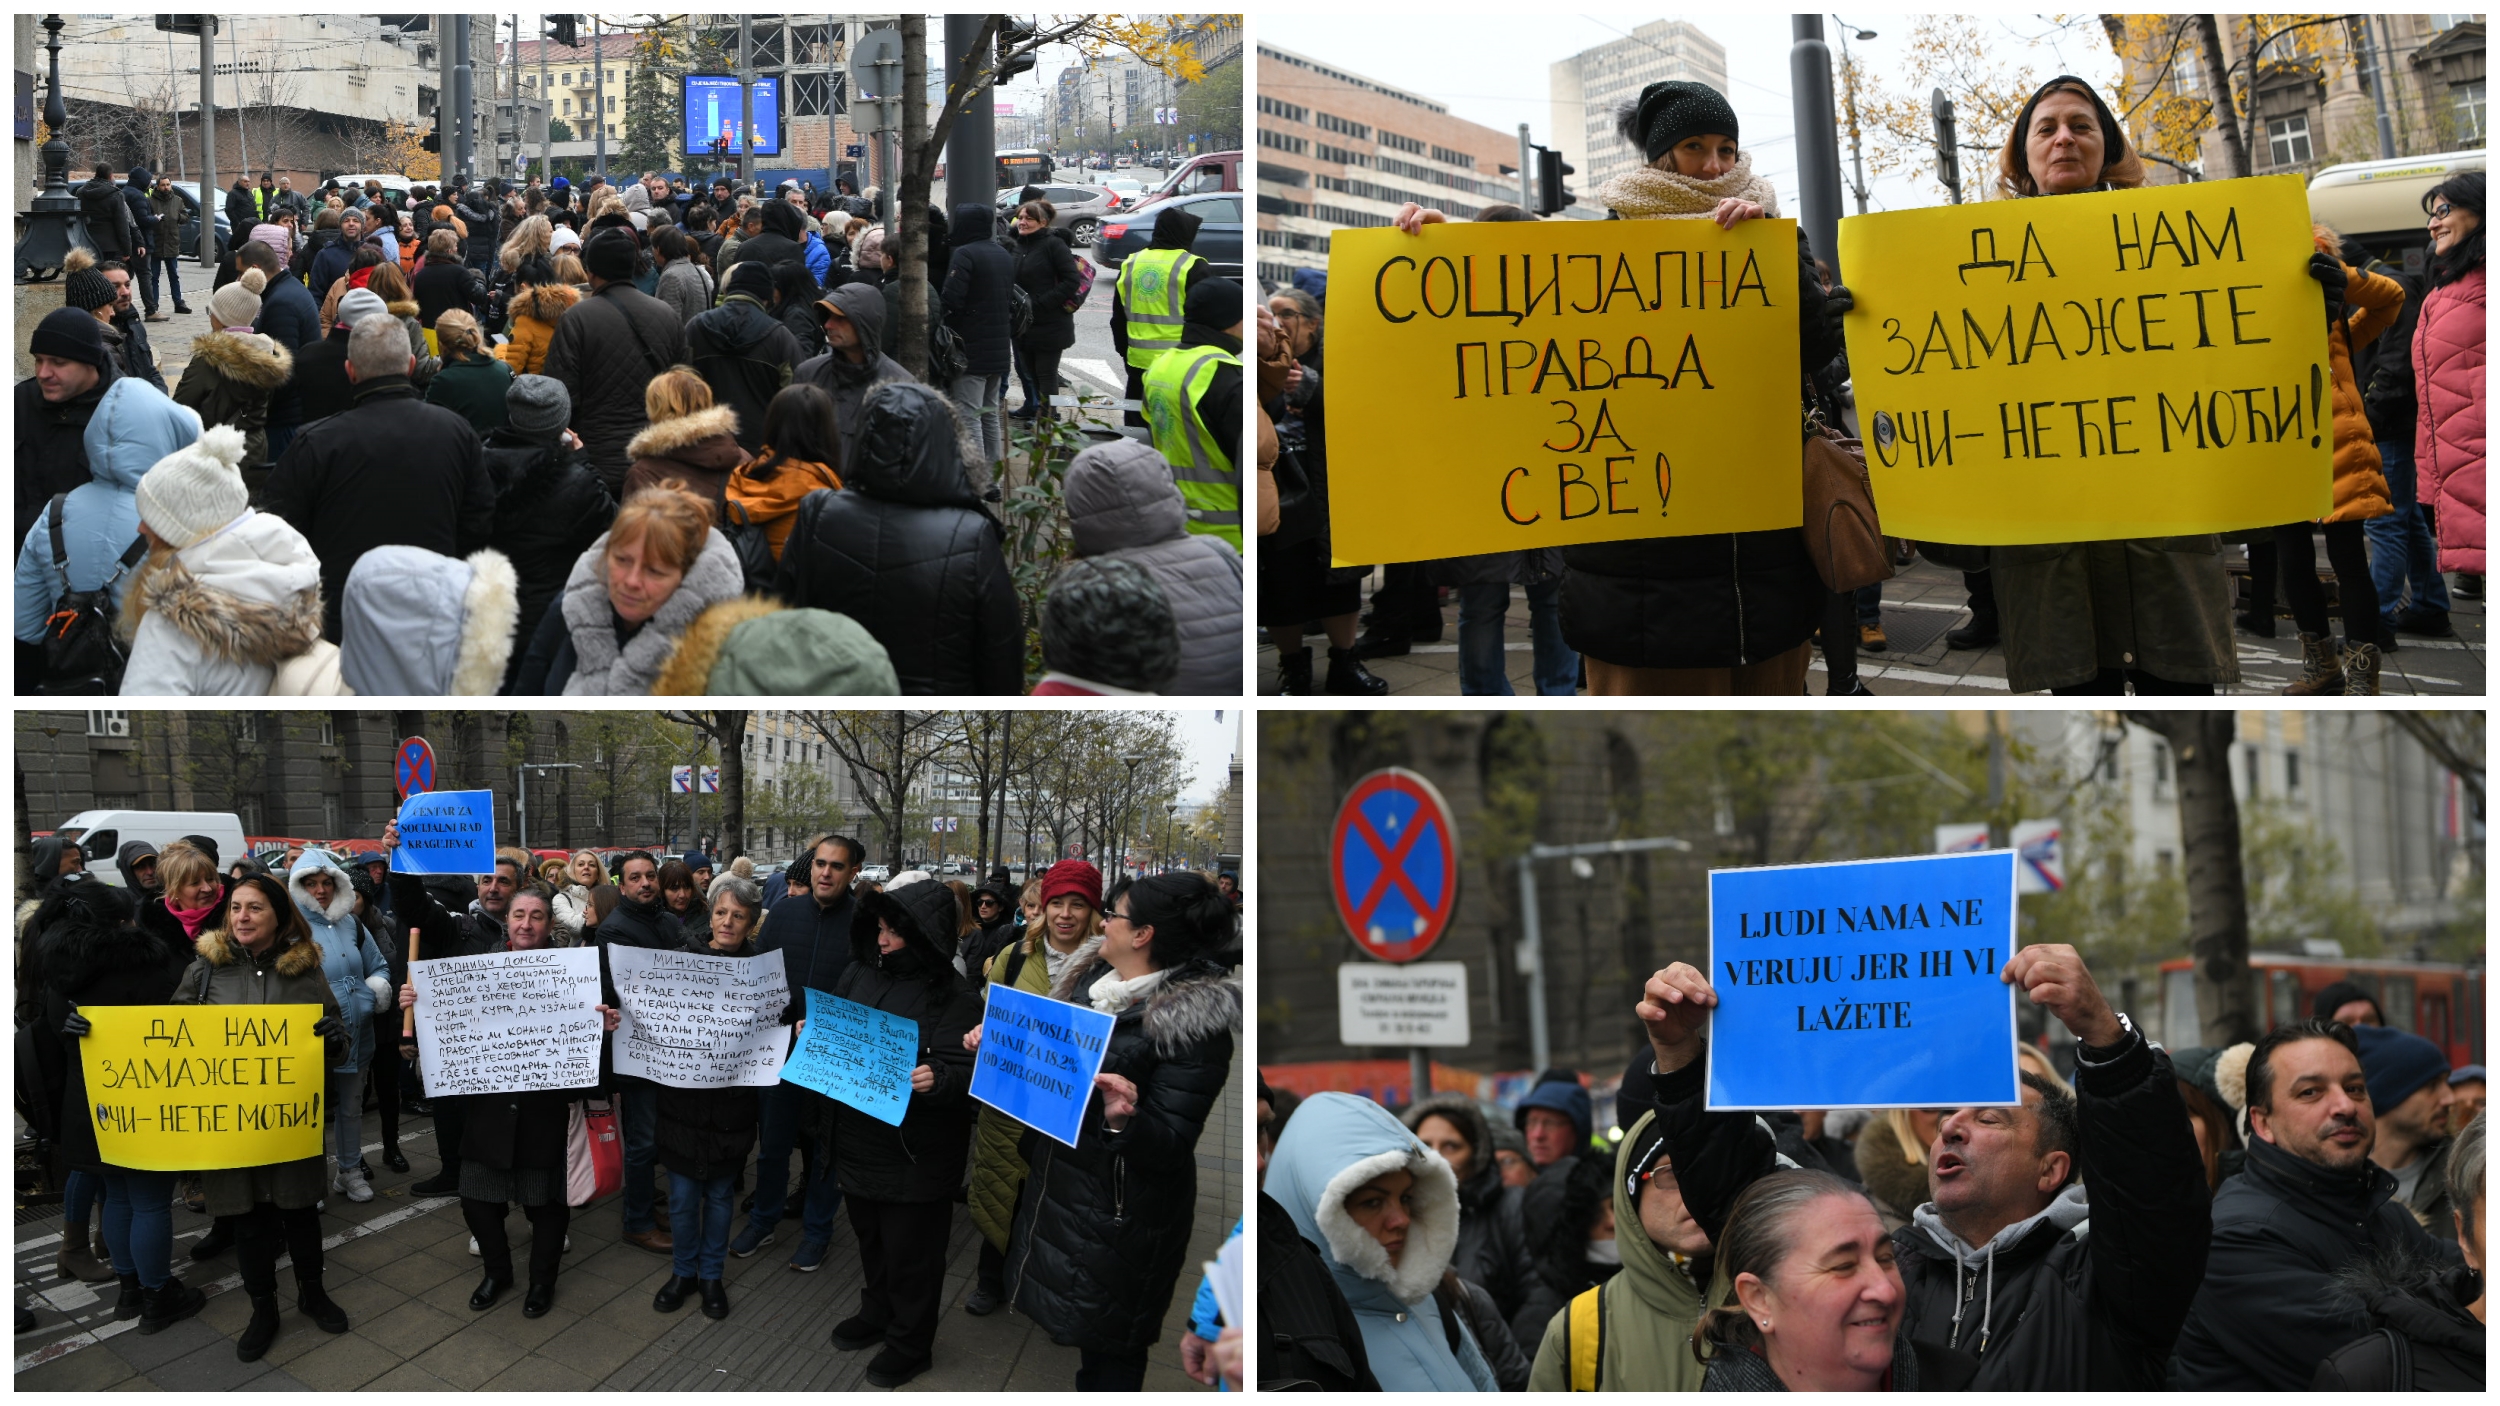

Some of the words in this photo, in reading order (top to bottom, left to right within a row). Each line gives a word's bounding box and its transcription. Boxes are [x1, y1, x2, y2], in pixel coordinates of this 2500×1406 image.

[2373, 165, 2446, 179] KONVEKTA
[1957, 221, 2058, 287] ДА
[2111, 206, 2247, 273] НАМ
[1374, 248, 1773, 326] СОЦИЈАЛНА
[1881, 284, 2272, 376] ЗАМАЖЕТЕ
[1454, 334, 1715, 399] ПРАВДА
[1999, 394, 2140, 460] НЕЋЕ
[2157, 362, 2323, 453] МОЋИ!
[1543, 398, 1637, 454] ЗА
[413, 806, 455, 817] CENTAR
[457, 805, 473, 816] ZA
[401, 823, 457, 834] SOCIJALNI
[459, 822, 482, 832] RAD
[407, 839, 477, 849] KRAGUJEVAC
[1740, 908, 1826, 939] LJUDI
[1836, 902, 1931, 933] NAMA
[1940, 899, 1983, 928] NE
[439, 959, 494, 975] РАДНИЦИ
[503, 954, 557, 970] ДОМСКОГ
[1724, 955, 1843, 987] VERUJU
[1851, 952, 1910, 983] JER
[1919, 950, 1953, 978] IH
[1964, 947, 1996, 976] VI
[432, 972, 488, 987] СМЕШТАЈА
[492, 971, 500, 980] У
[505, 965, 567, 980] СОЦИЈАЛНОЈ
[476, 984, 491, 993] СУ
[552, 976, 598, 989] РАДИЛИ
[623, 968, 632, 981] У
[639, 970, 720, 986] СОЦИЈАЛНОЈ
[731, 971, 781, 987] ЗАШТИТИ
[432, 999, 455, 1008] СМО
[457, 995, 477, 1005] СВЕ
[482, 992, 516, 1002] ВРЕМЕ
[623, 983, 639, 994] НЕ
[644, 984, 676, 998] РАДЕ
[681, 988, 715, 1000] САМО
[540, 1001, 586, 1013] УЗЈАШЕ
[637, 997, 715, 1013] МЕДИЦИНСКЕ
[721, 1003, 762, 1014] СЕСТРЕ
[1797, 996, 1912, 1032] LAŽETE
[635, 1009, 681, 1022] ВИСОКО
[687, 1014, 752, 1028] ОБРАЗОВАН
[987, 1004, 1016, 1025] BROJ
[1017, 1014, 1103, 1053] ZAPOSLENIH
[144, 1018, 195, 1048] ДА
[224, 1017, 288, 1047] НАМ
[487, 1031, 502, 1040] ЛИ
[507, 1025, 553, 1036] КОНАЧНО
[481, 1038, 548, 1053] ШКОЛОВАНОГ
[552, 1033, 601, 1046] МИНИСТРА
[758, 1045, 775, 1053] НА
[989, 1029, 1025, 1053] MANJI
[1025, 1042, 1042, 1061] ZA
[1045, 1049, 1080, 1074] 18.2%
[442, 1049, 541, 1070] ЗАИНТЕРЕСОВАНОГ
[545, 1048, 560, 1057] ЗА
[485, 1061, 551, 1074] СОЛИДАРНА
[678, 1062, 701, 1071] СМО
[761, 1057, 775, 1066] СЕ
[983, 1051, 998, 1067] OD
[101, 1056, 296, 1089] ЗАМАЖЕТЕ
[434, 1081, 448, 1089] ЗА
[449, 1077, 491, 1090] ДОМСКИ
[495, 1072, 548, 1084] СМЕШТАЈ
[552, 1070, 559, 1080] У
[560, 1068, 595, 1078] СРБИЈИ
[646, 1066, 687, 1081] БУДИМО
[524, 1082, 560, 1091] ГРАДСКИ
[159, 1104, 228, 1132] НЕЋЕ
[238, 1092, 320, 1131] МОЋИ!
